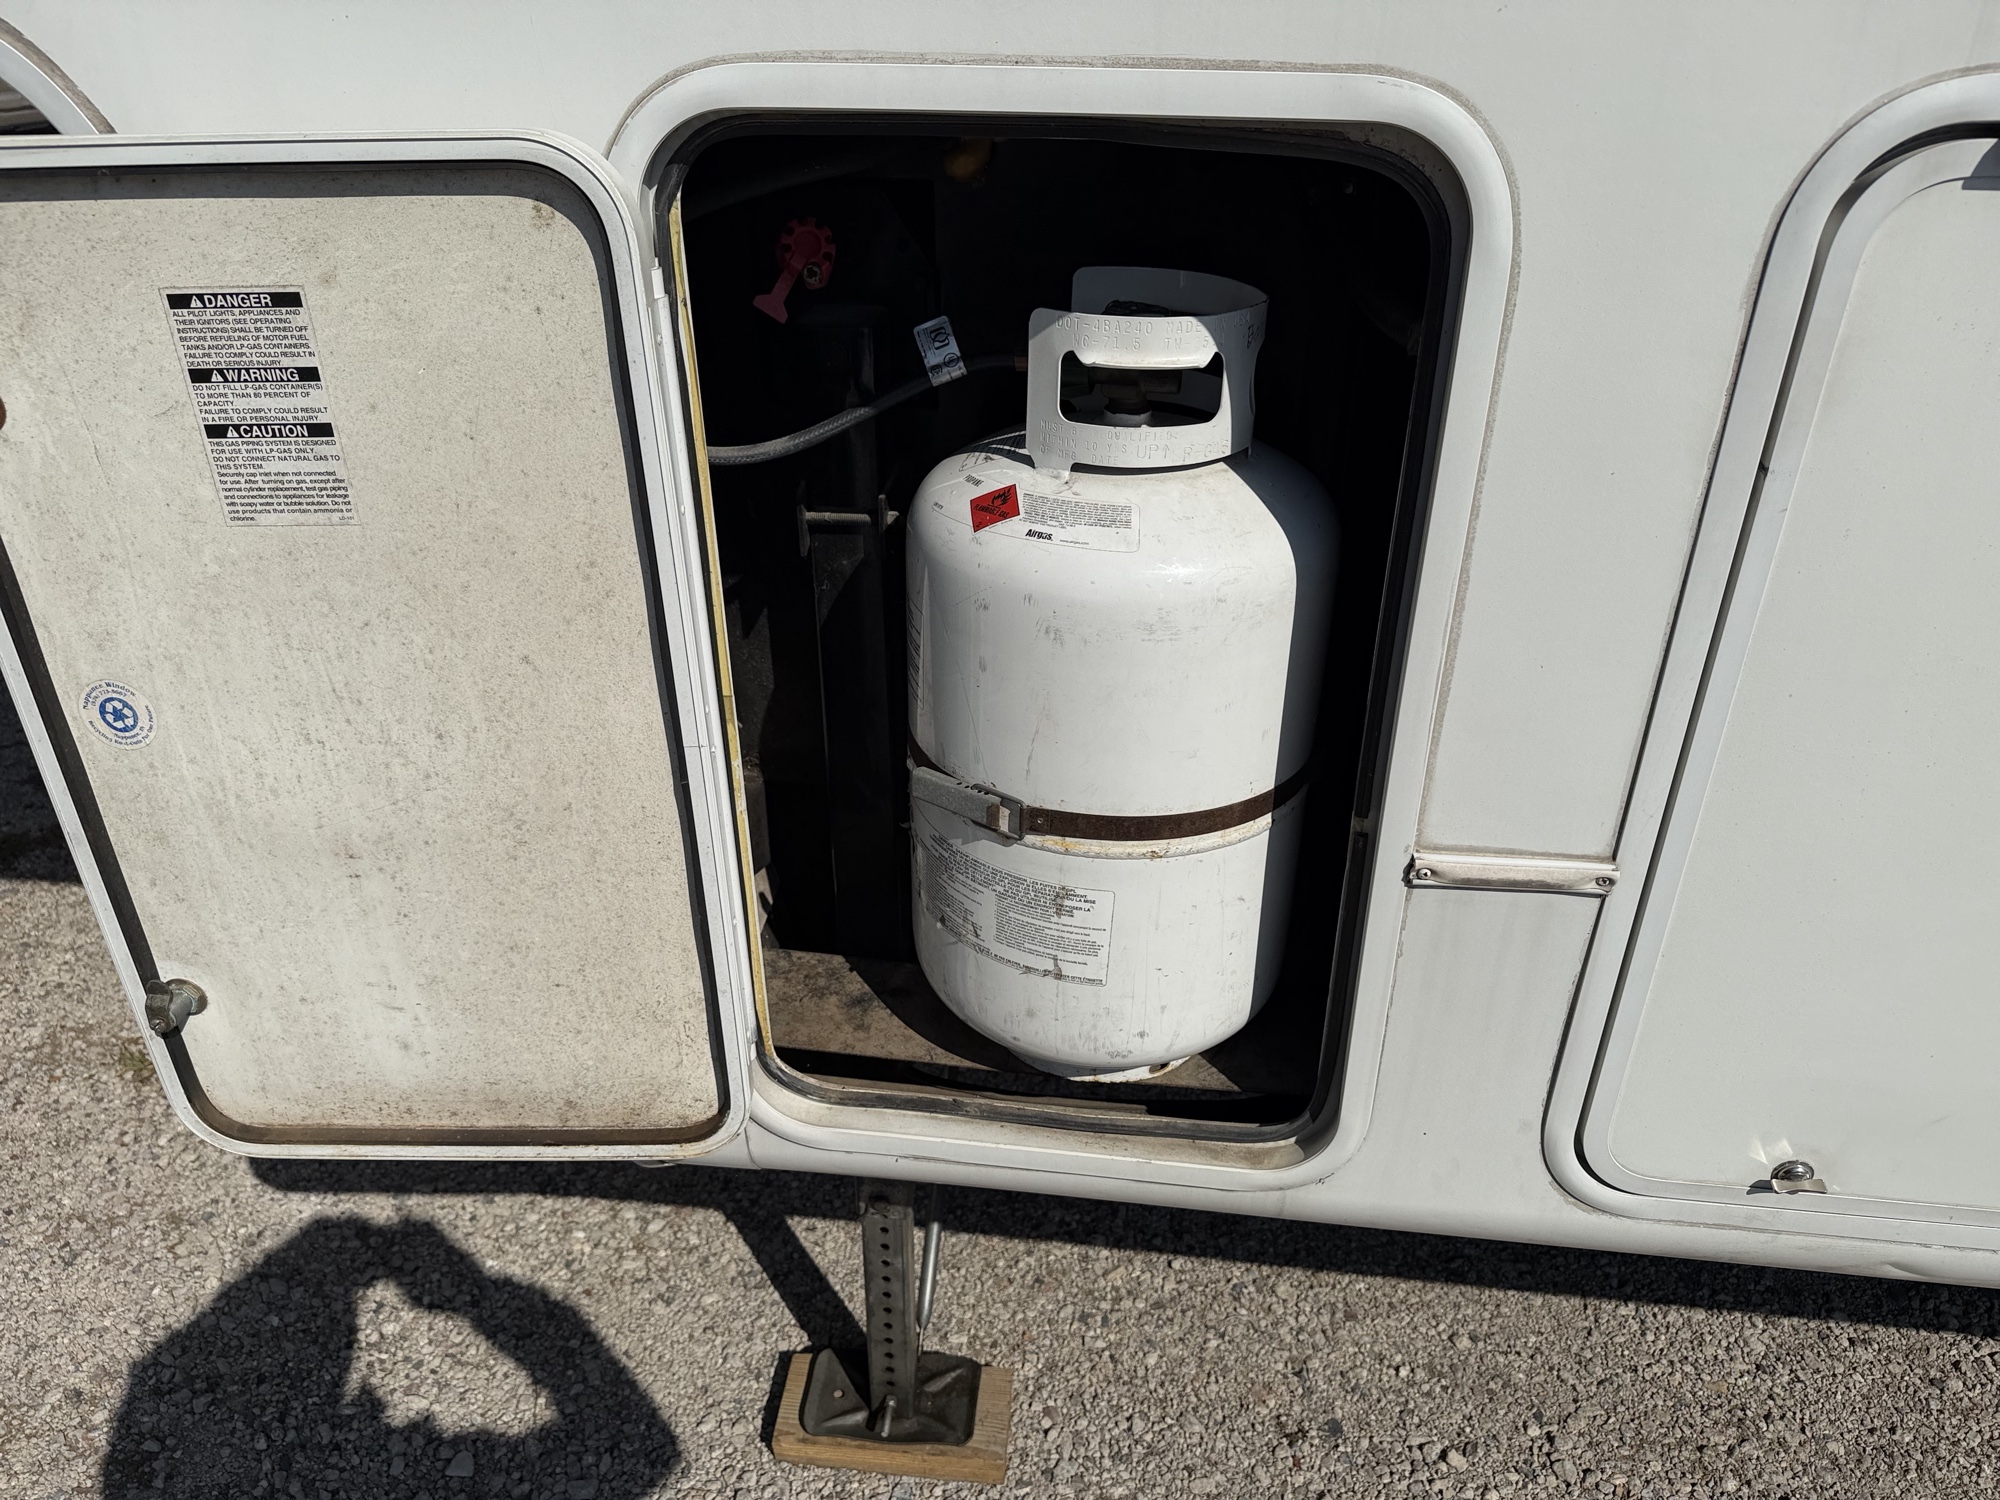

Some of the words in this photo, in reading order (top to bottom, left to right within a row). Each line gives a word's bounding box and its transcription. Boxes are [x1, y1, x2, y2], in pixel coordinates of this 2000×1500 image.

[203, 294, 272, 307] DANGER
[223, 368, 299, 381] WARNING
[239, 425, 308, 437] CAUTION
